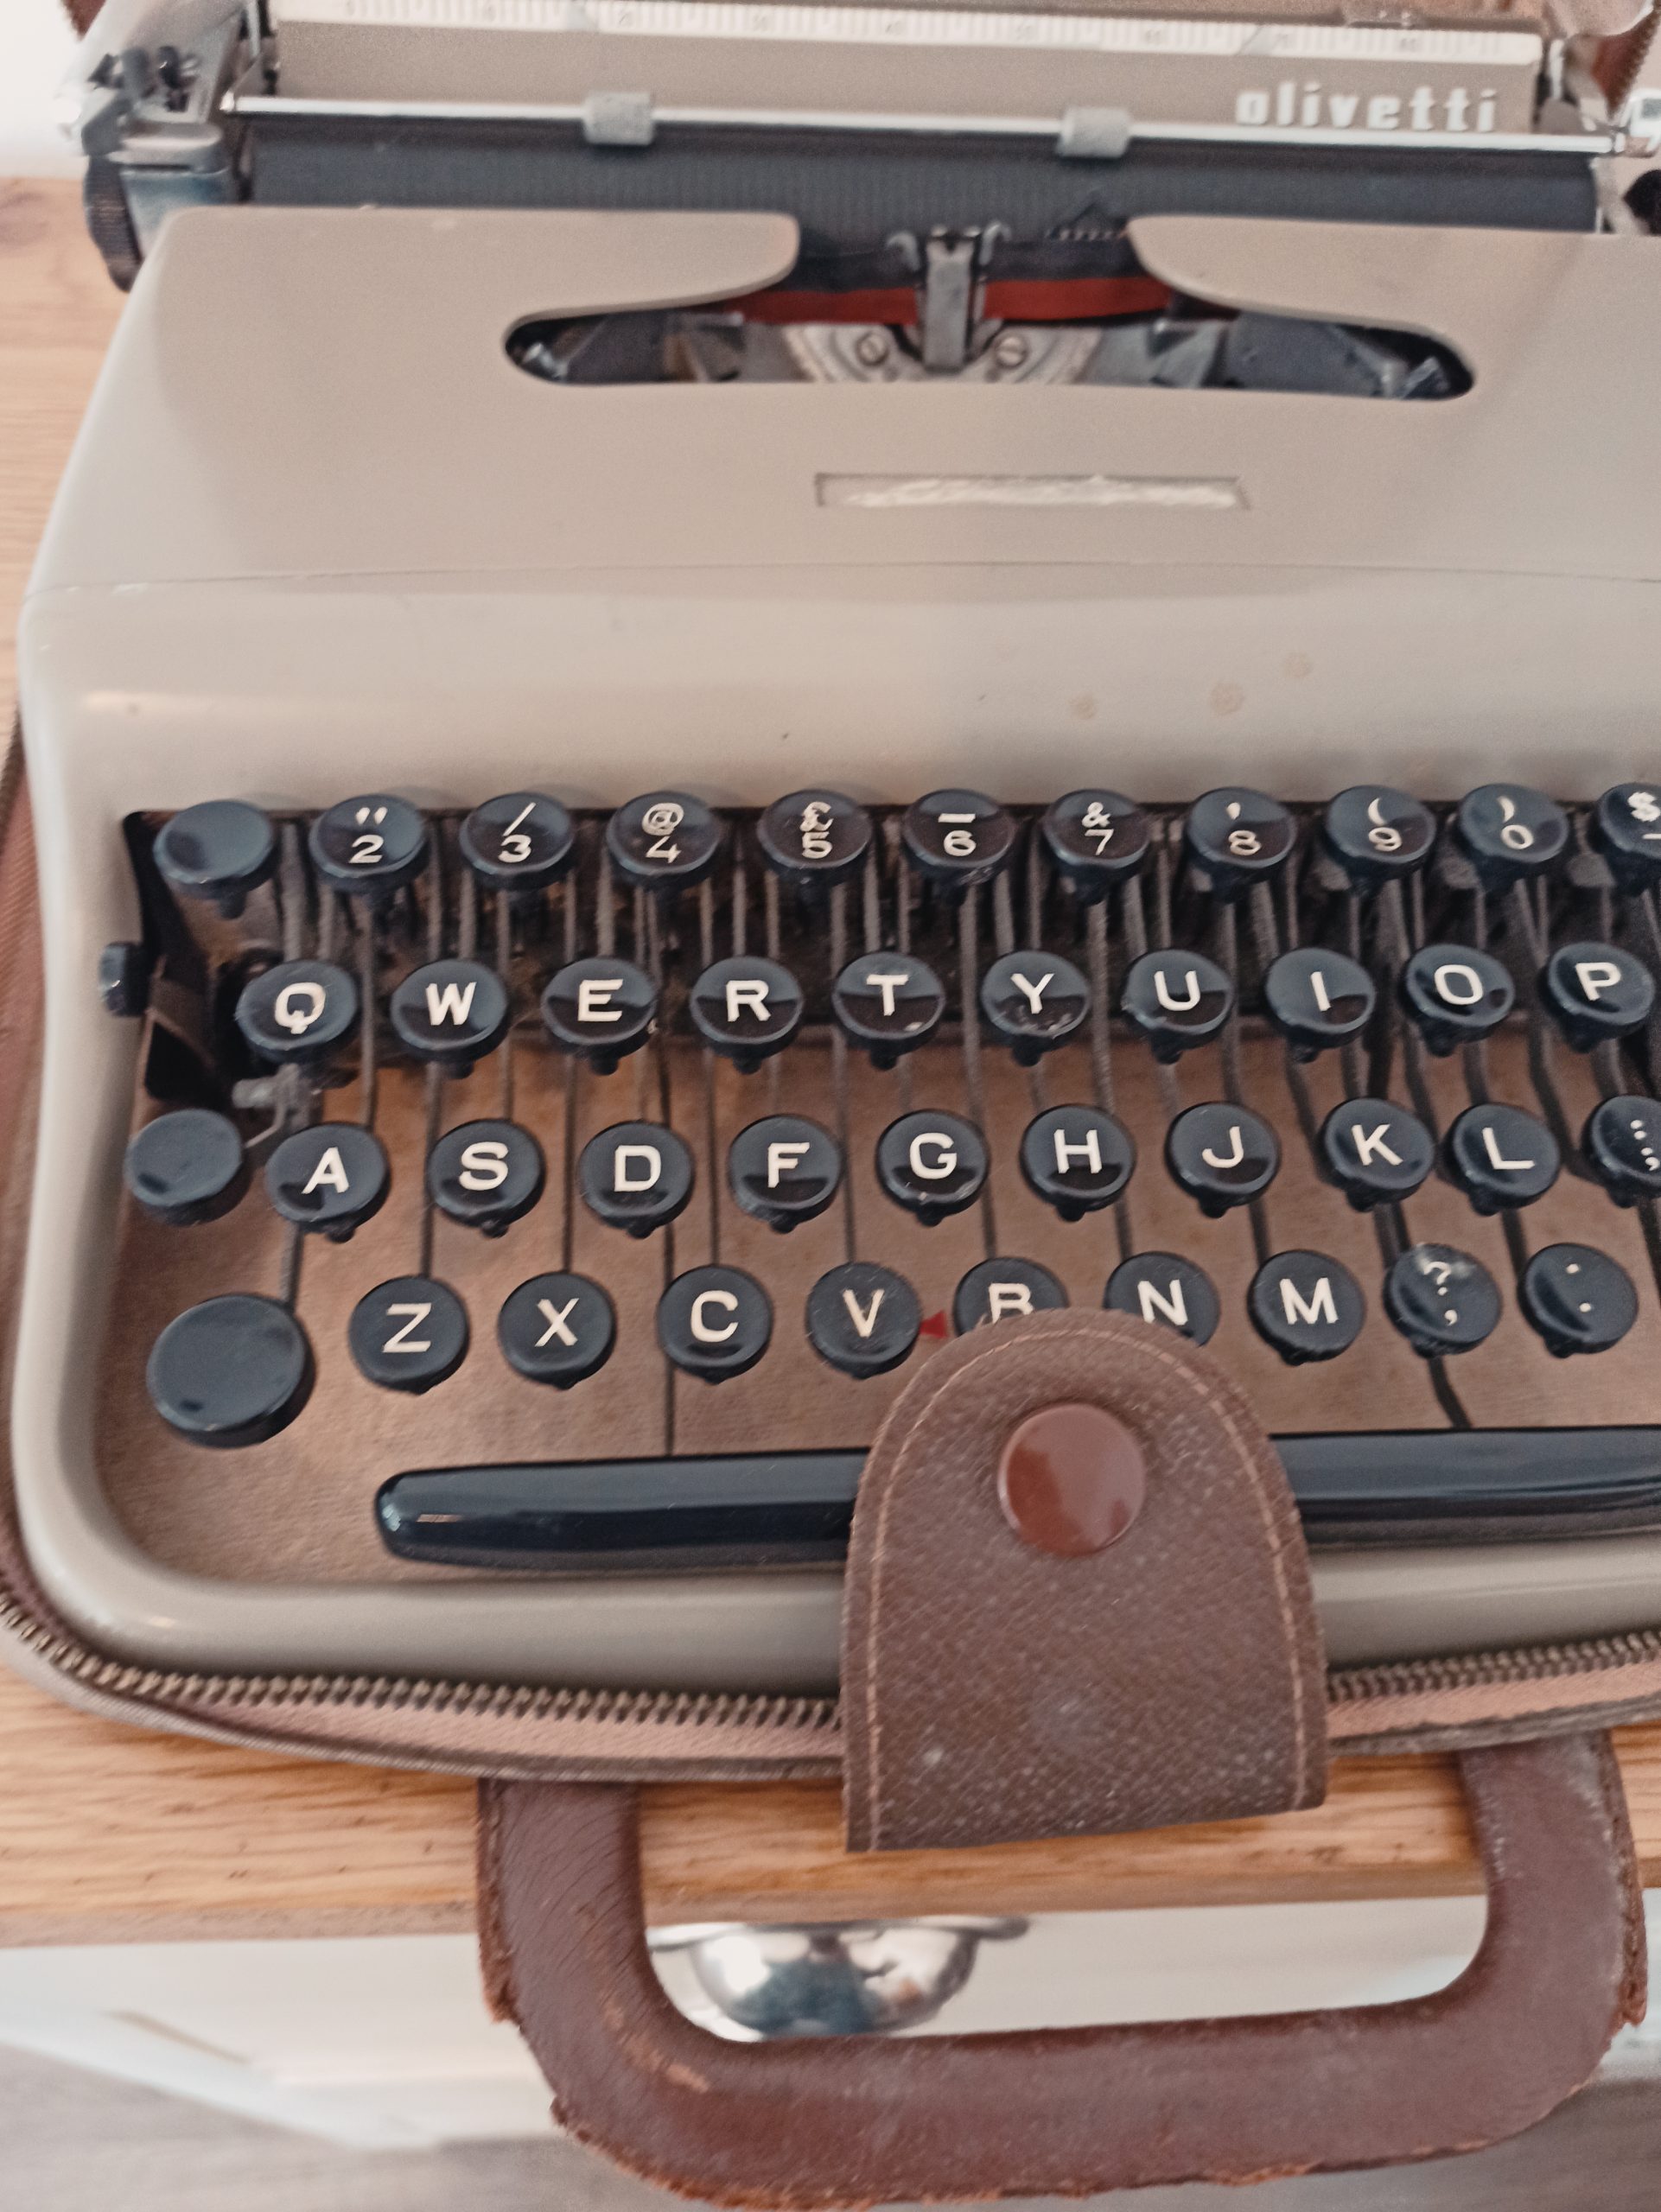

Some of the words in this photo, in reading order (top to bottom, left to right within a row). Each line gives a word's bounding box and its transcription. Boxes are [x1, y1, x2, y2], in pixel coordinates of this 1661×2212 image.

[1235, 80, 1496, 131] olivetti
[641, 802, 684, 836] @
[1081, 801, 1111, 828] &
[349, 834, 385, 864] 2
[498, 834, 532, 864] 3
[646, 835, 681, 864] 4
[801, 830, 833, 860] 5
[943, 830, 977, 857] 6
[1085, 828, 1115, 855] 7
[1228, 830, 1262, 855] 8
[1367, 826, 1402, 852] 9
[577, 978, 624, 1022] E
[725, 979, 772, 1023] R
[865, 973, 909, 1017] T
[1010, 972, 1055, 1014] Y
[1153, 969, 1201, 1012] U
[1310, 970, 1332, 1012] I
[1433, 963, 1484, 1006] O
[1575, 961, 1622, 1001] P
[274, 981, 327, 1035] Q
[425, 981, 477, 1027] W
[458, 1141, 509, 1192] S
[767, 1141, 811, 1189] F
[908, 1131, 958, 1180] G
[1053, 1128, 1103, 1174] H
[1201, 1125, 1244, 1169] J
[1351, 1123, 1403, 1166] K
[1481, 1127, 1536, 1171] L
[302, 1147, 350, 1195] A
[614, 1144, 662, 1192] D
[1422, 1259, 1454, 1297] ?
[534, 1297, 580, 1347] X
[690, 1289, 739, 1343] C
[843, 1288, 885, 1338] V
[1136, 1278, 1189, 1326] N
[1279, 1276, 1339, 1325] M
[383, 1302, 432, 1354] Z
